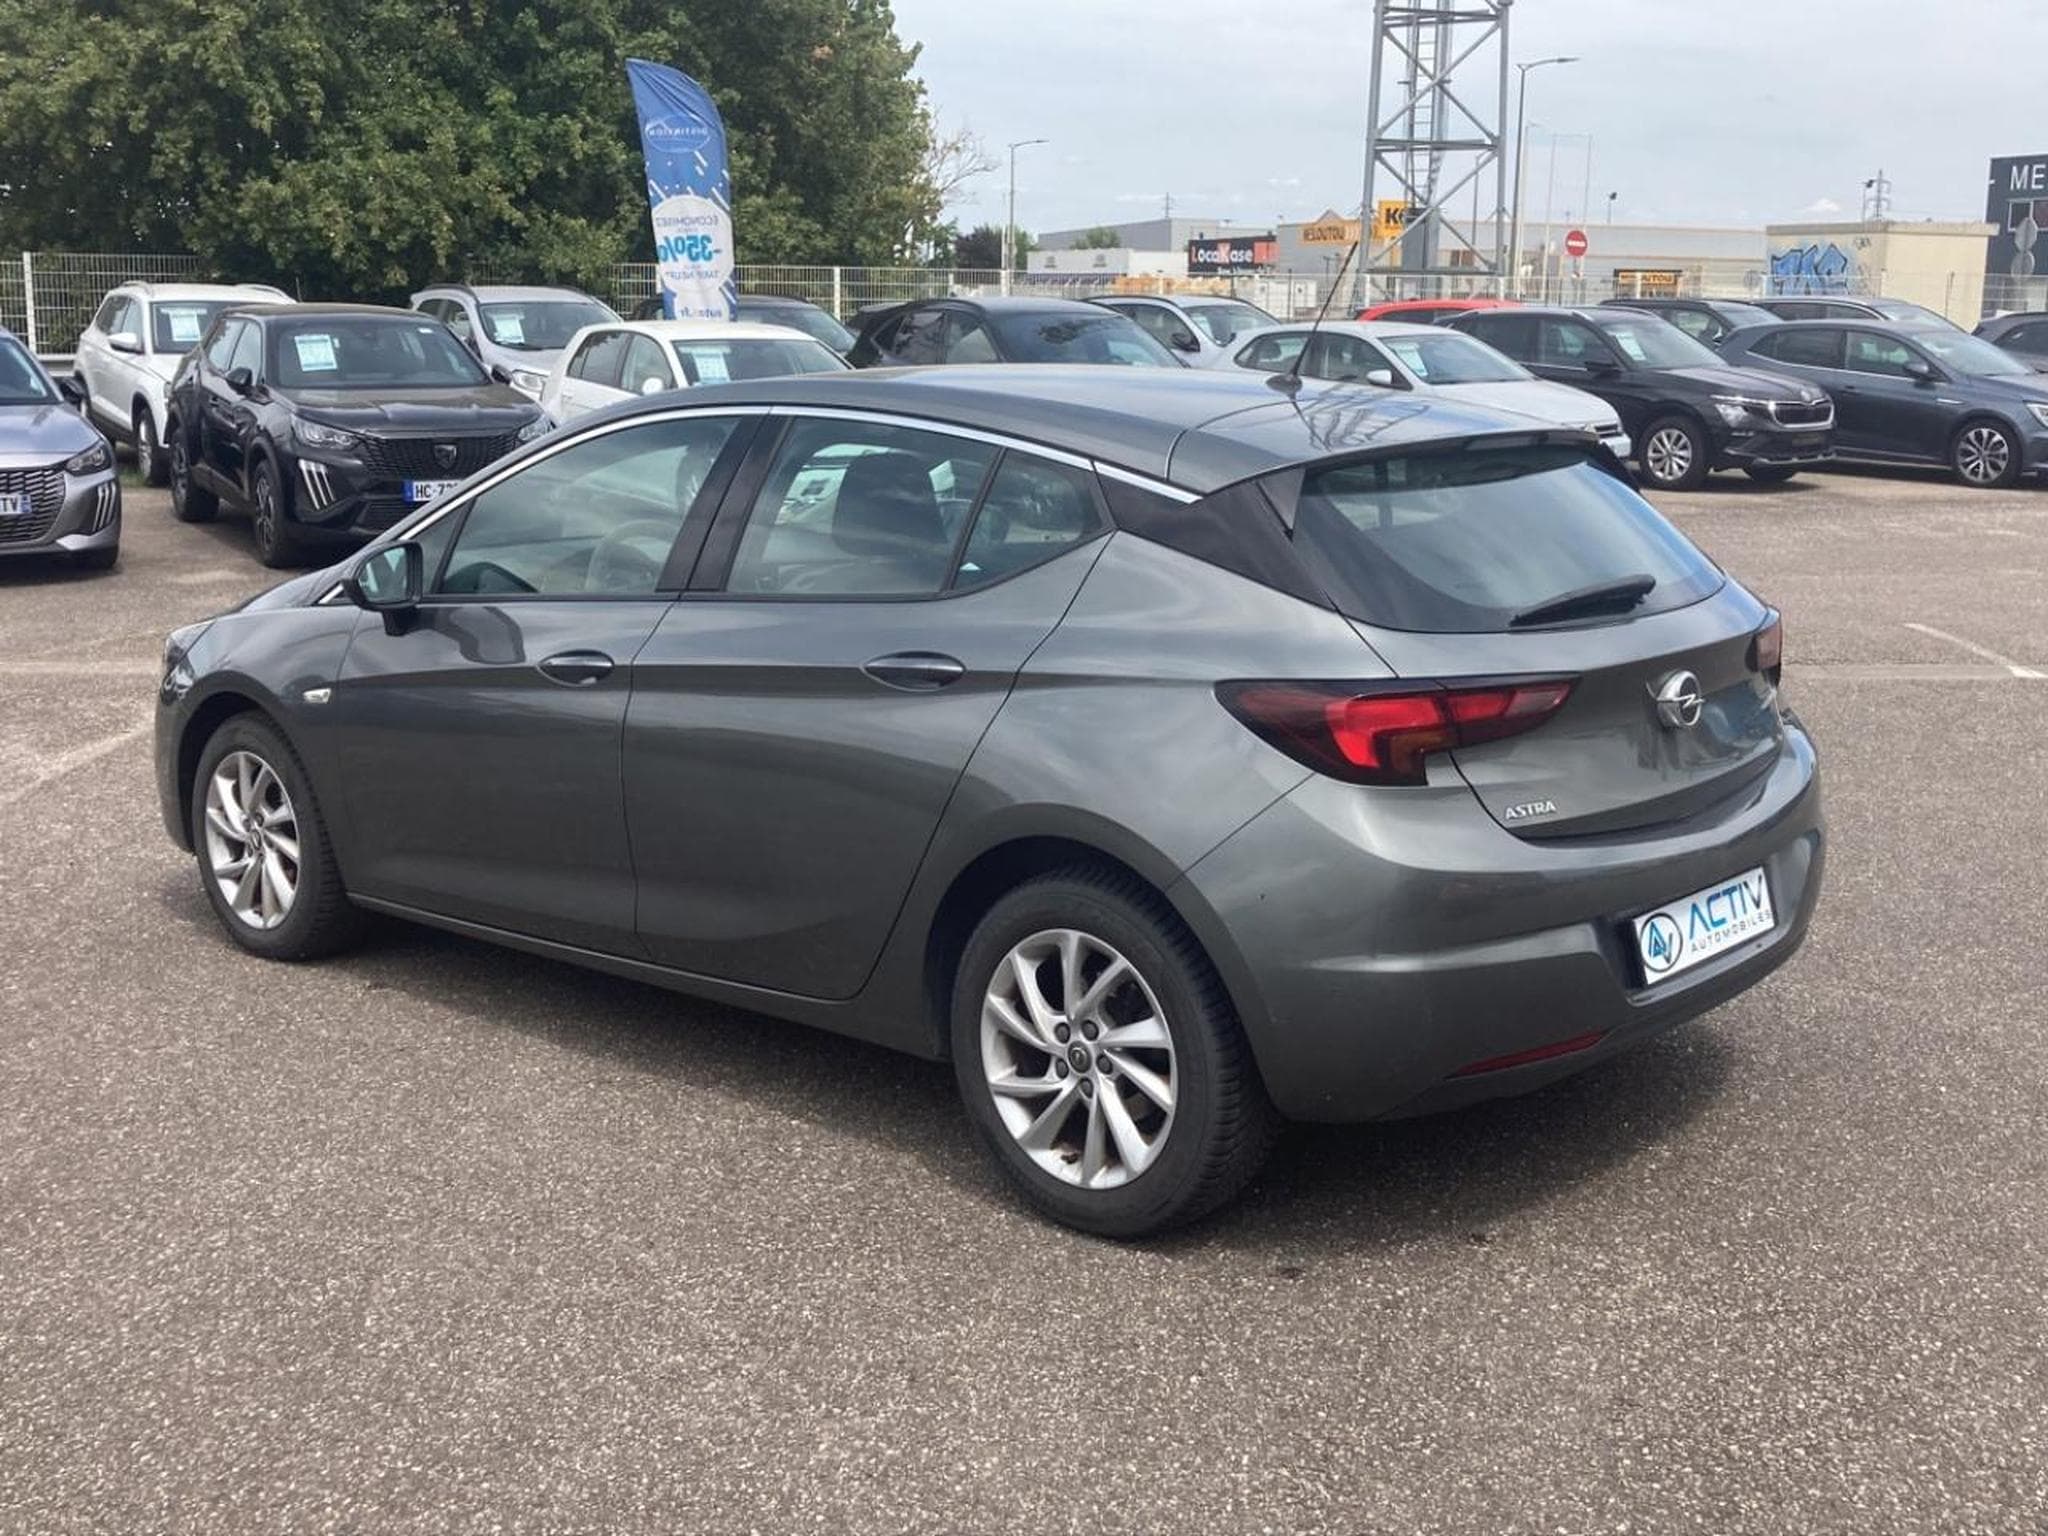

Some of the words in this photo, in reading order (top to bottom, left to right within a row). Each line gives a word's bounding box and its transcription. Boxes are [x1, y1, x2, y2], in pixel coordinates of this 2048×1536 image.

[2009, 163, 2047, 191] ME
[415, 482, 458, 499] HC-7
[1506, 801, 1556, 820] ASTRA
[1689, 874, 1762, 940] ACTIV
[1691, 909, 1771, 952] AUTOMOBILES
